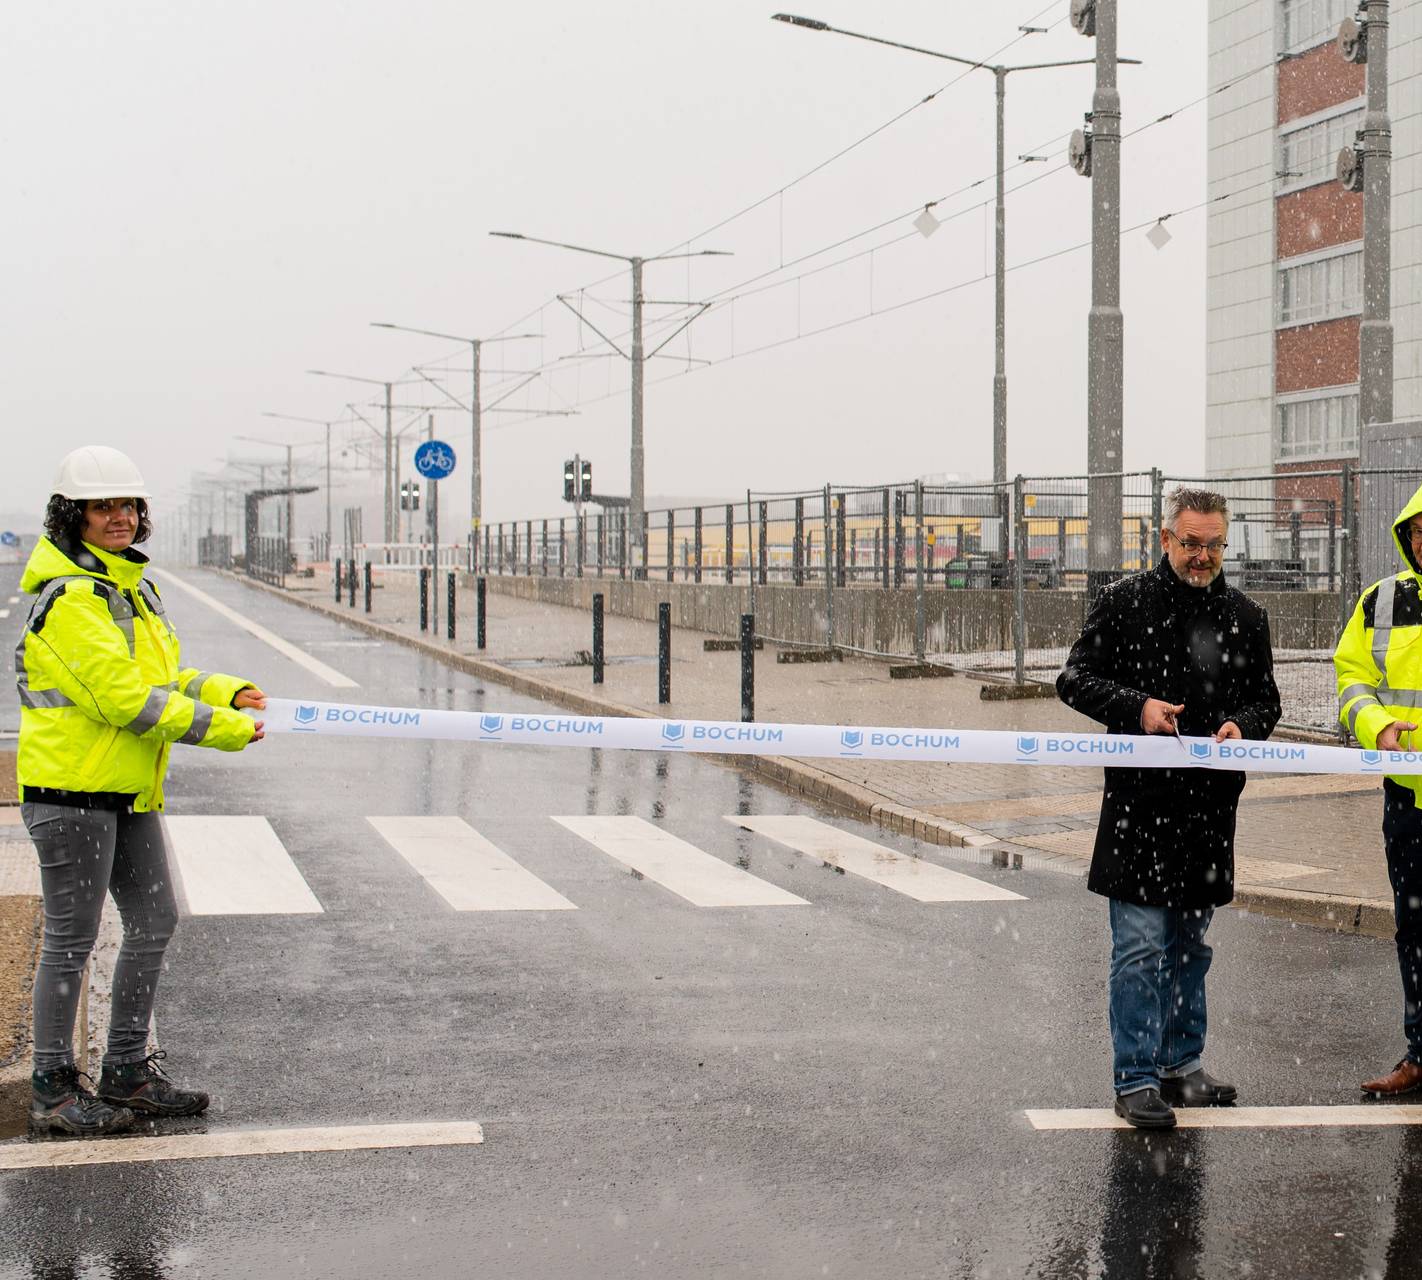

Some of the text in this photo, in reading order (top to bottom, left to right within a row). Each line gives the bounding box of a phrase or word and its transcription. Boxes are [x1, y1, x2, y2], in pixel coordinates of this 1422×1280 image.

[326, 709, 420, 725] BOCHUM
[511, 718, 604, 733] BOCHUM
[693, 727, 783, 741] BOCHUM
[871, 734, 960, 748] BOCHUM
[1046, 739, 1135, 754] BOCHUM
[1219, 745, 1306, 759] BOCHUM
